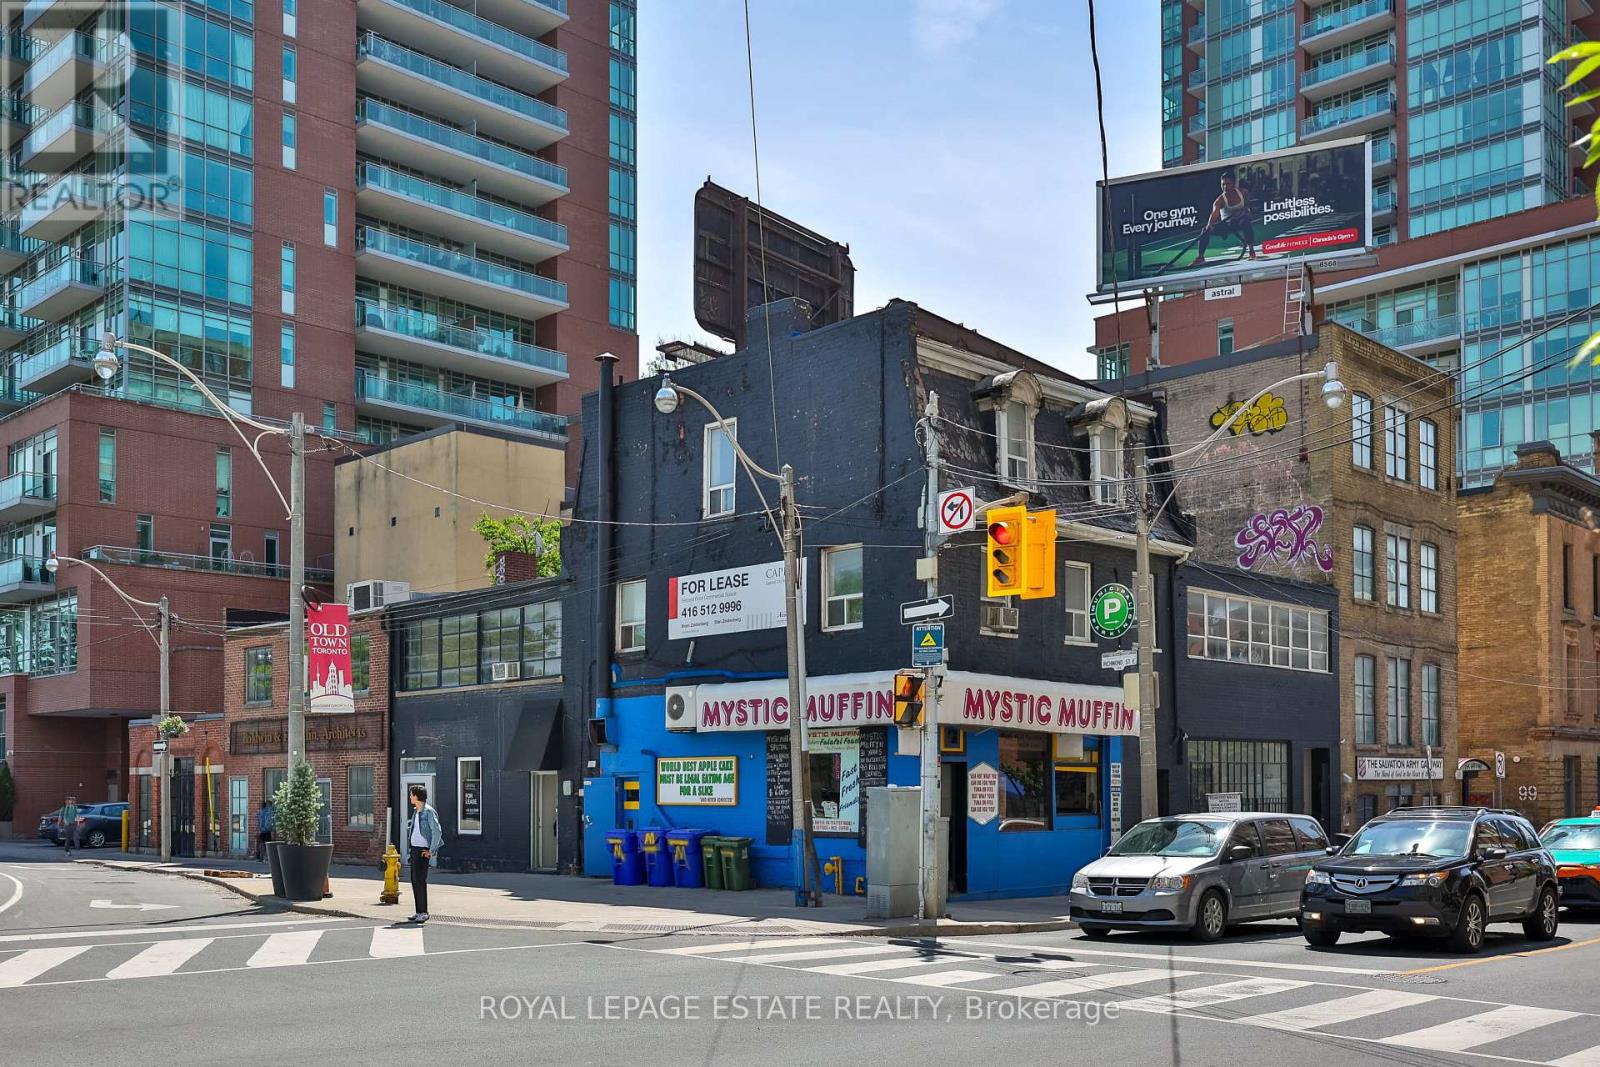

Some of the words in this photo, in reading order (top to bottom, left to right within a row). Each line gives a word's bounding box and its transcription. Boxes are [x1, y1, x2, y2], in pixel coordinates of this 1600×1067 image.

[1263, 197, 1315, 212] Limitless
[1144, 210, 1168, 220] One
[1170, 206, 1198, 219] gym.
[1263, 204, 1334, 225] possibilities.
[1122, 223, 1153, 234] Every
[1153, 216, 1198, 232] journey.
[1211, 287, 1235, 297] astral
[681, 578, 706, 596] FOR
[709, 573, 749, 591] LEASE
[681, 606, 698, 618] 416
[700, 603, 717, 616] 512
[719, 600, 742, 613] 9996
[1103, 598, 1121, 620] P
[310, 623, 348, 637] OLD
[311, 637, 348, 648] TOWN
[312, 647, 348, 655] TORONTO
[701, 697, 788, 727] MYSTIC
[807, 690, 895, 722] MUFFIN
[963, 687, 1052, 725] MYSTIC
[1058, 697, 1134, 731] MUFFIN
[323, 726, 366, 742] Architects
[660, 761, 681, 771] WORLD
[682, 761, 697, 771] BEST
[698, 761, 717, 771] APPLE
[718, 760, 734, 771] CAKE
[1367, 760, 1378, 768] THE
[1378, 760, 1405, 768] SALVATION
[1406, 760, 1420, 768] ARMY
[660, 774, 674, 784] MUST
[676, 774, 683, 783] BE
[723, 773, 734, 783] AGE
[680, 786, 691, 795] FOR
[692, 786, 697, 795] A
[698, 786, 713, 795] SLICE
[1519, 786, 1537, 800] 99
